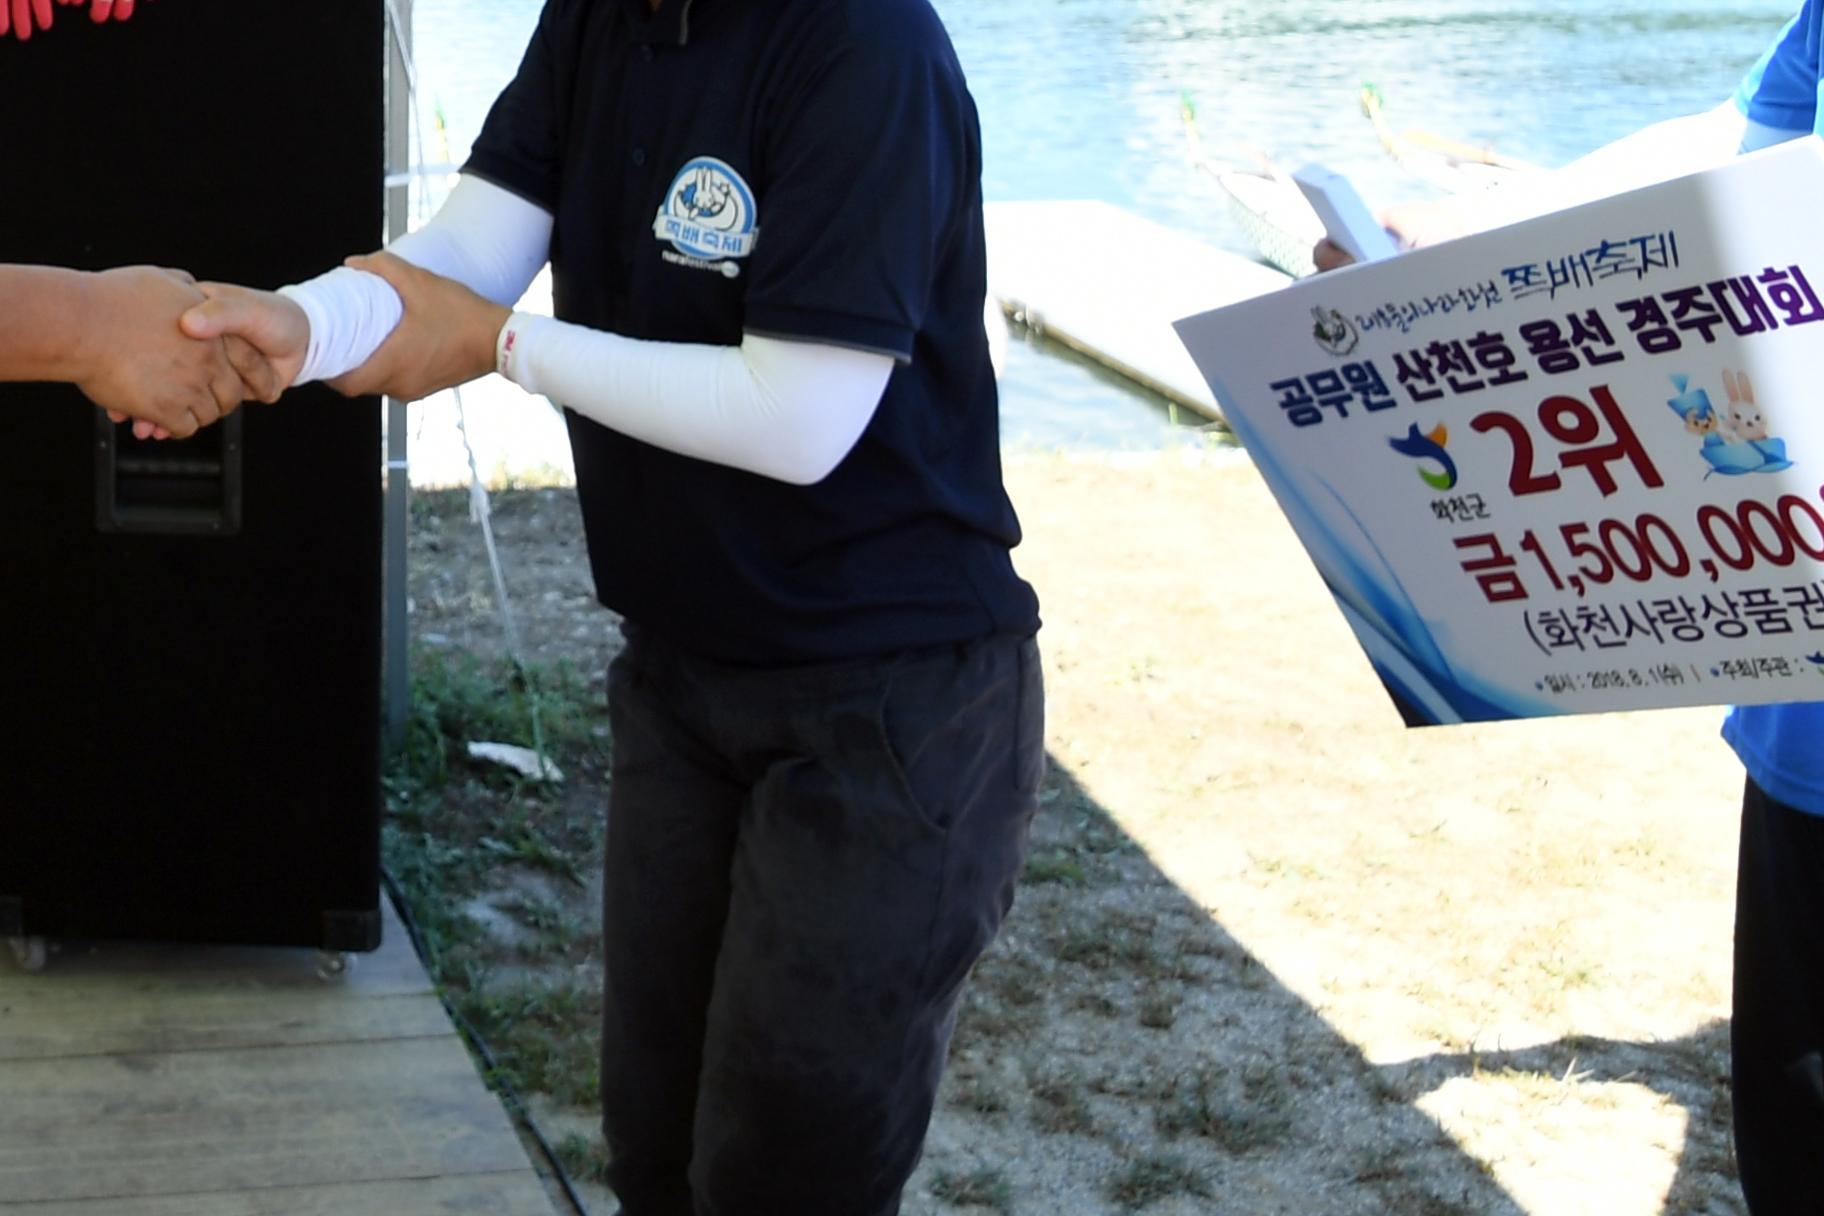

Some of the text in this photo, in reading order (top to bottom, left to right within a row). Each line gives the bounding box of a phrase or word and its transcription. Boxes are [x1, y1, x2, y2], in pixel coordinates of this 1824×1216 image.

[1269, 264, 1824, 429] 공무원 산천호 용선 경주대회
[1469, 384, 1666, 498] 2위
[1429, 492, 1493, 522] 화천군
